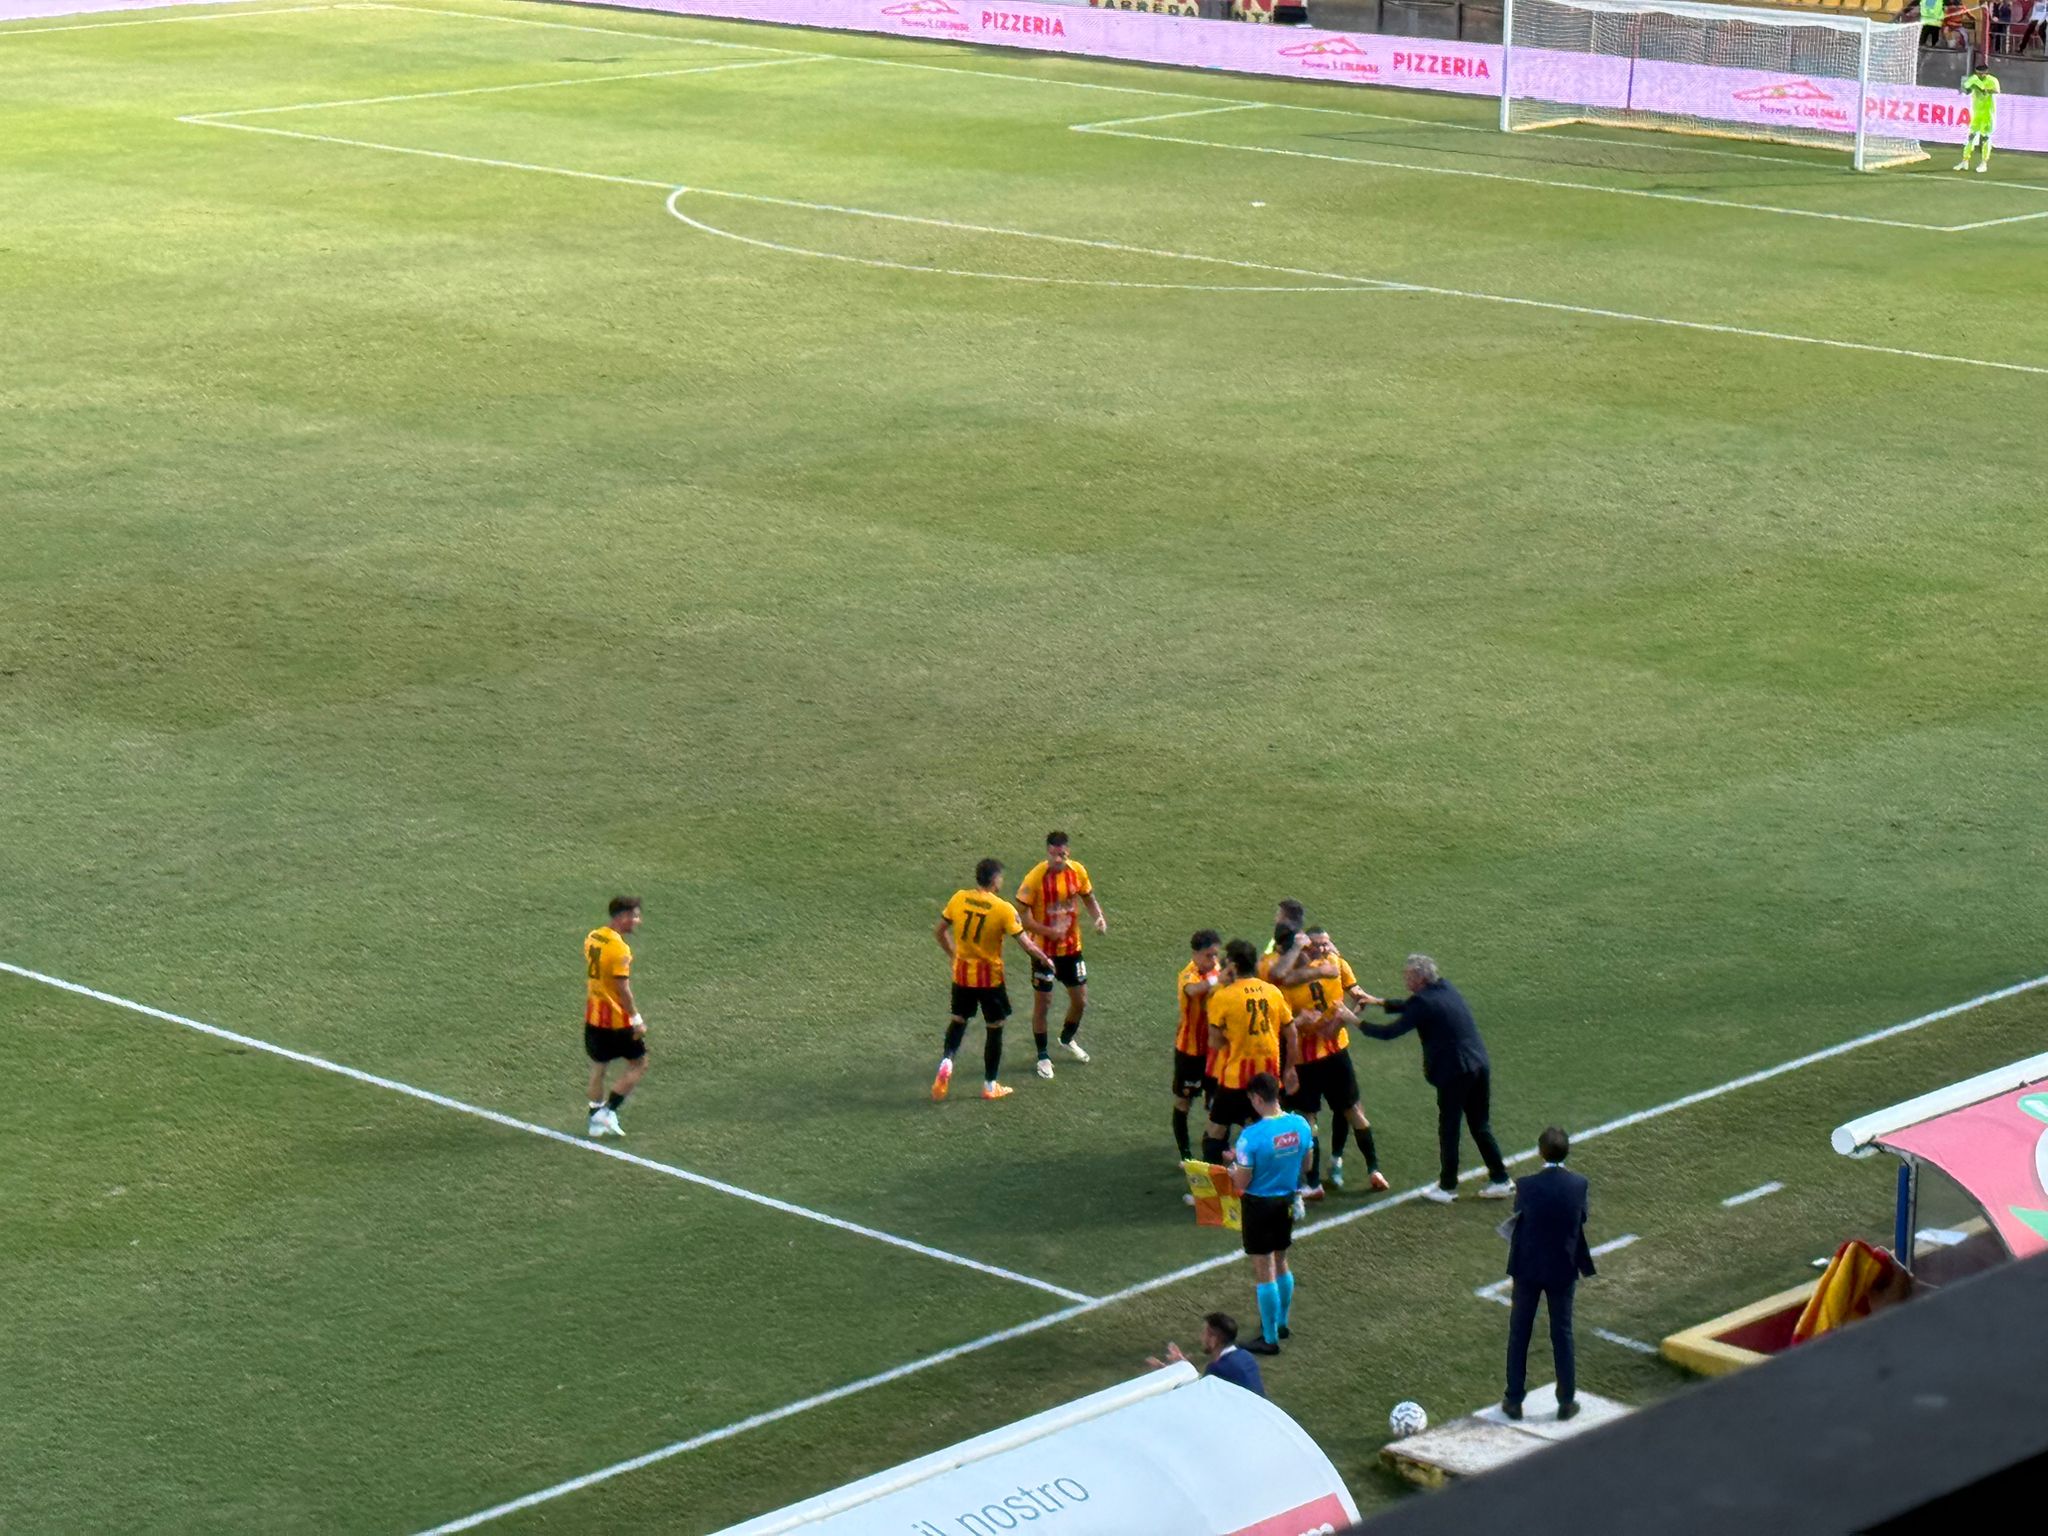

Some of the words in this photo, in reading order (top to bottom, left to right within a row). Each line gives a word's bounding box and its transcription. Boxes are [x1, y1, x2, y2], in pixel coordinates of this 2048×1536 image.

[982, 11, 1066, 37] PIZZERIA
[1393, 52, 1490, 79] PIZZERIA
[1866, 97, 1972, 127] PIZZERIA
[954, 1477, 1089, 1536] nostro
